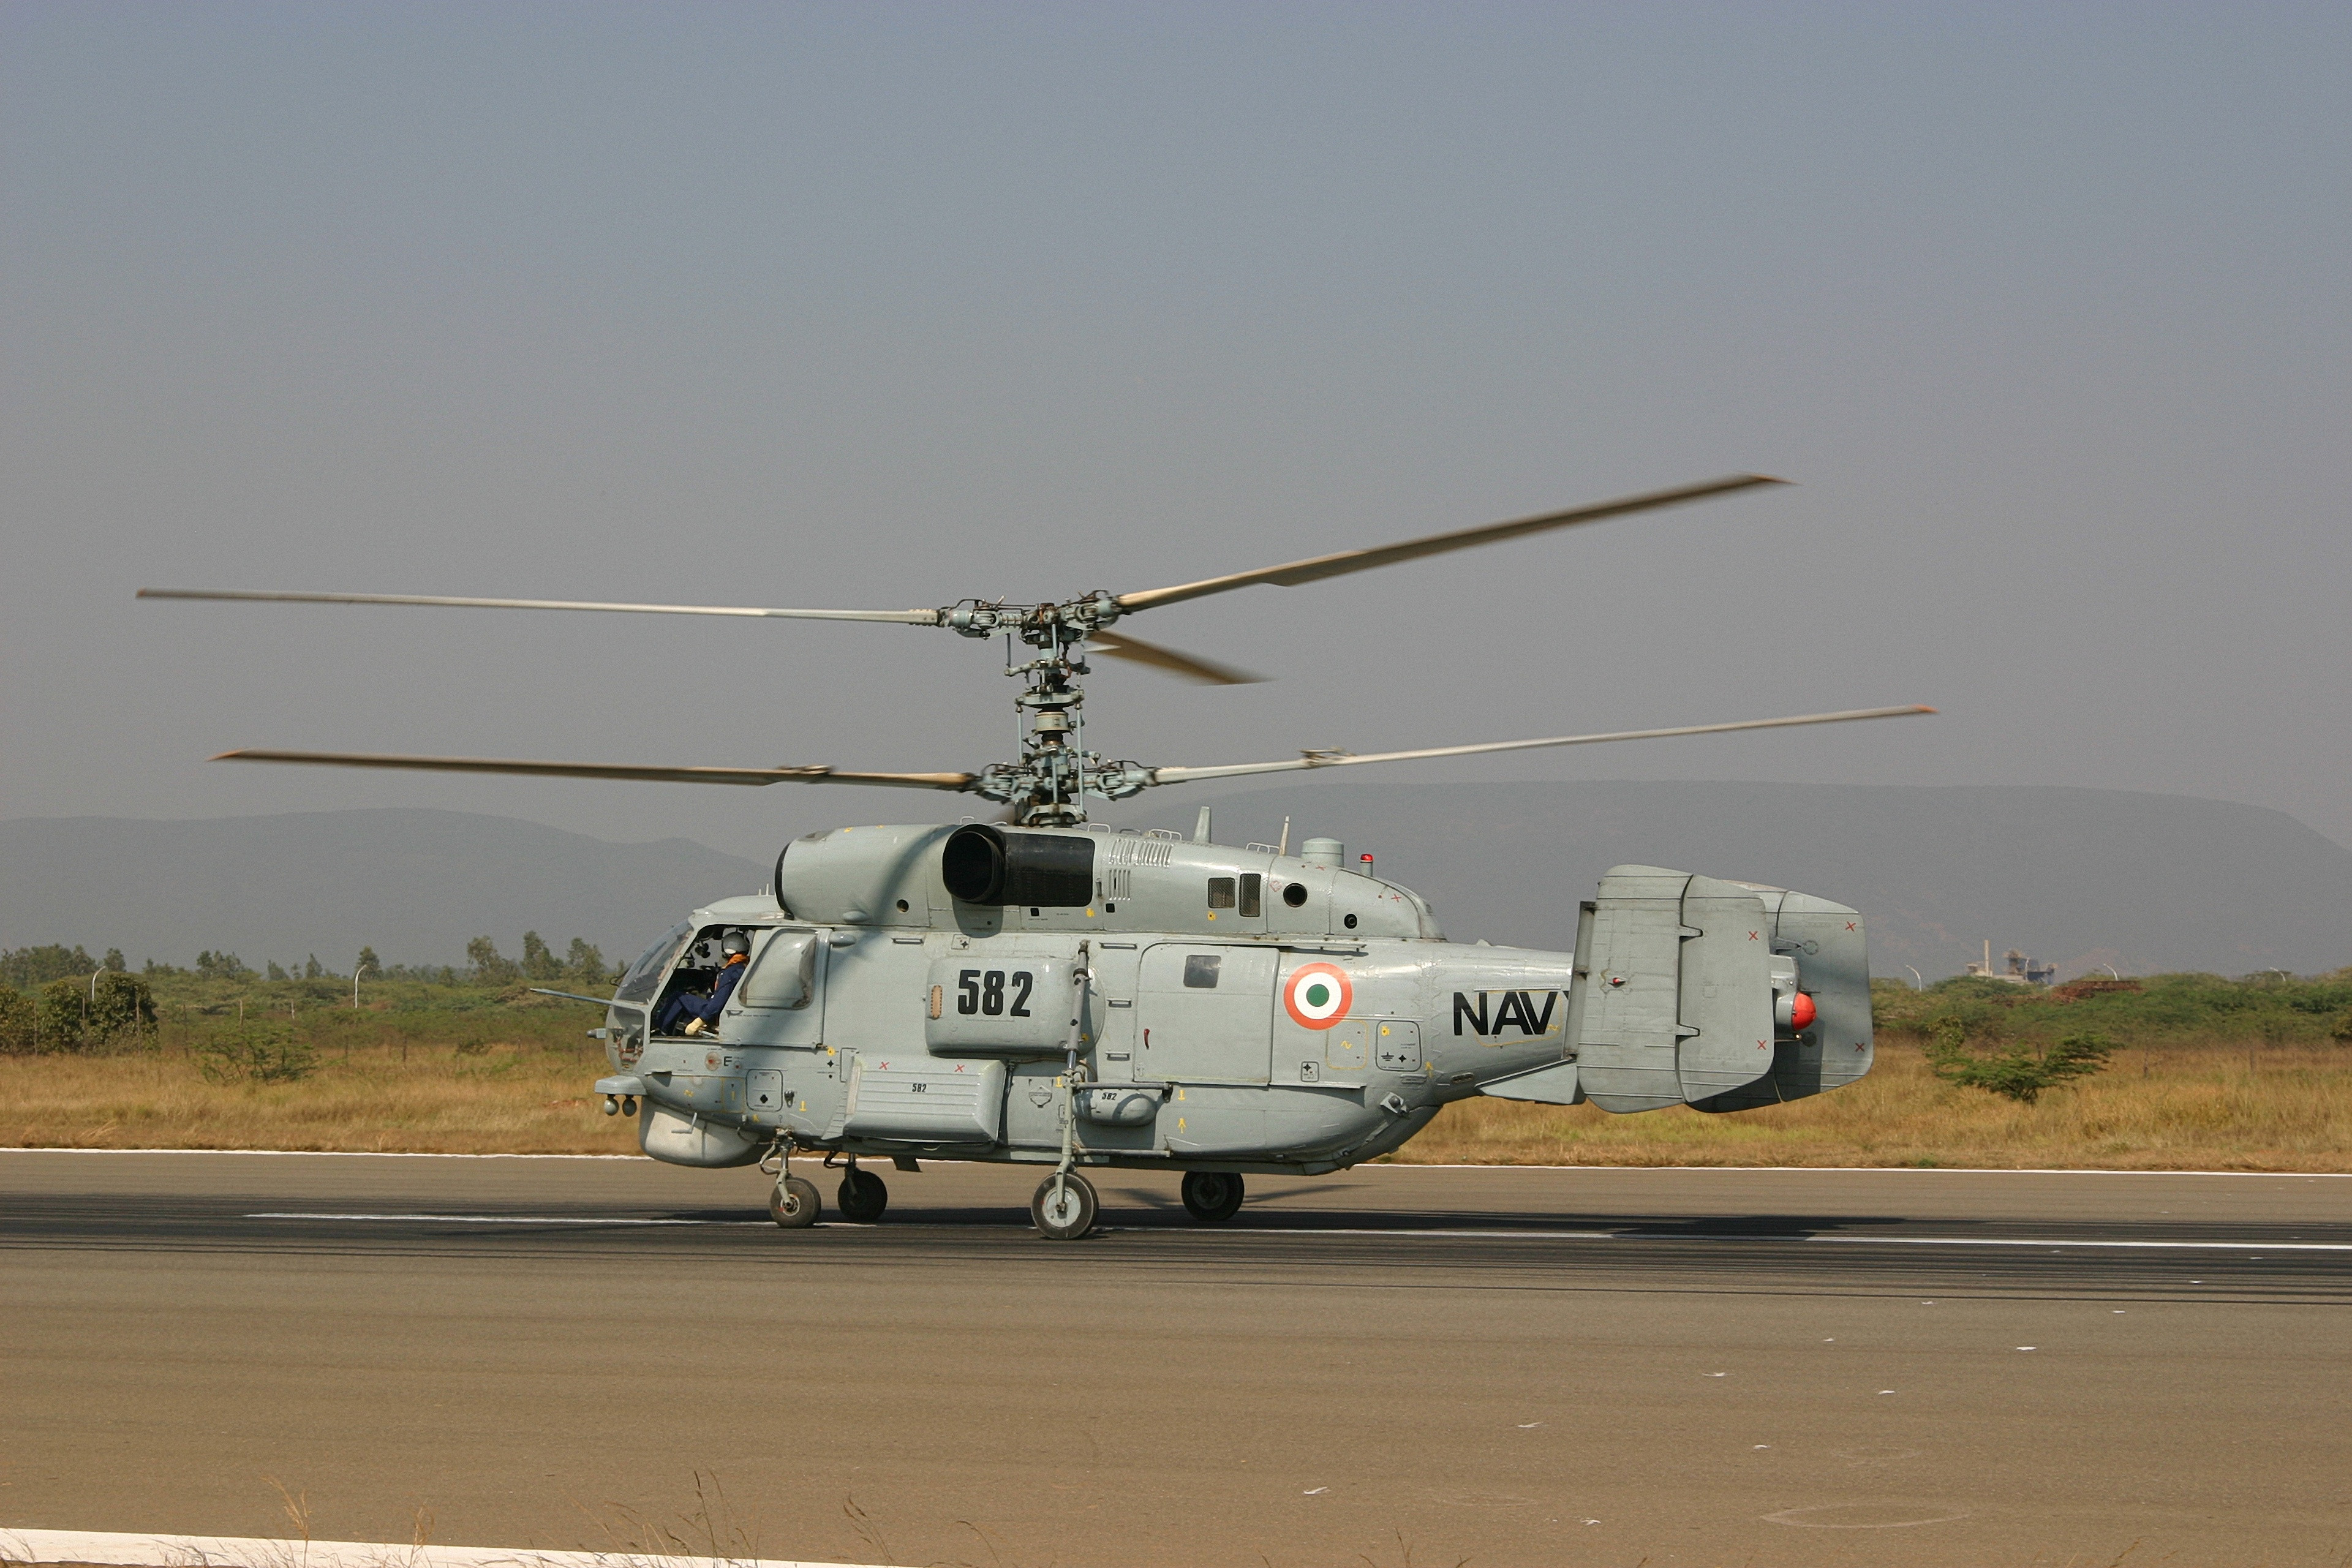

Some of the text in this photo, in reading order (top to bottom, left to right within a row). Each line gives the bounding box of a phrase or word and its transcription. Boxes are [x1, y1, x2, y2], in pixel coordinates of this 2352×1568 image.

[958, 970, 1033, 1017] 582
[1453, 991, 1569, 1036] NAV
[912, 1083, 927, 1093] 582
[1102, 1092, 1117, 1101] 582
